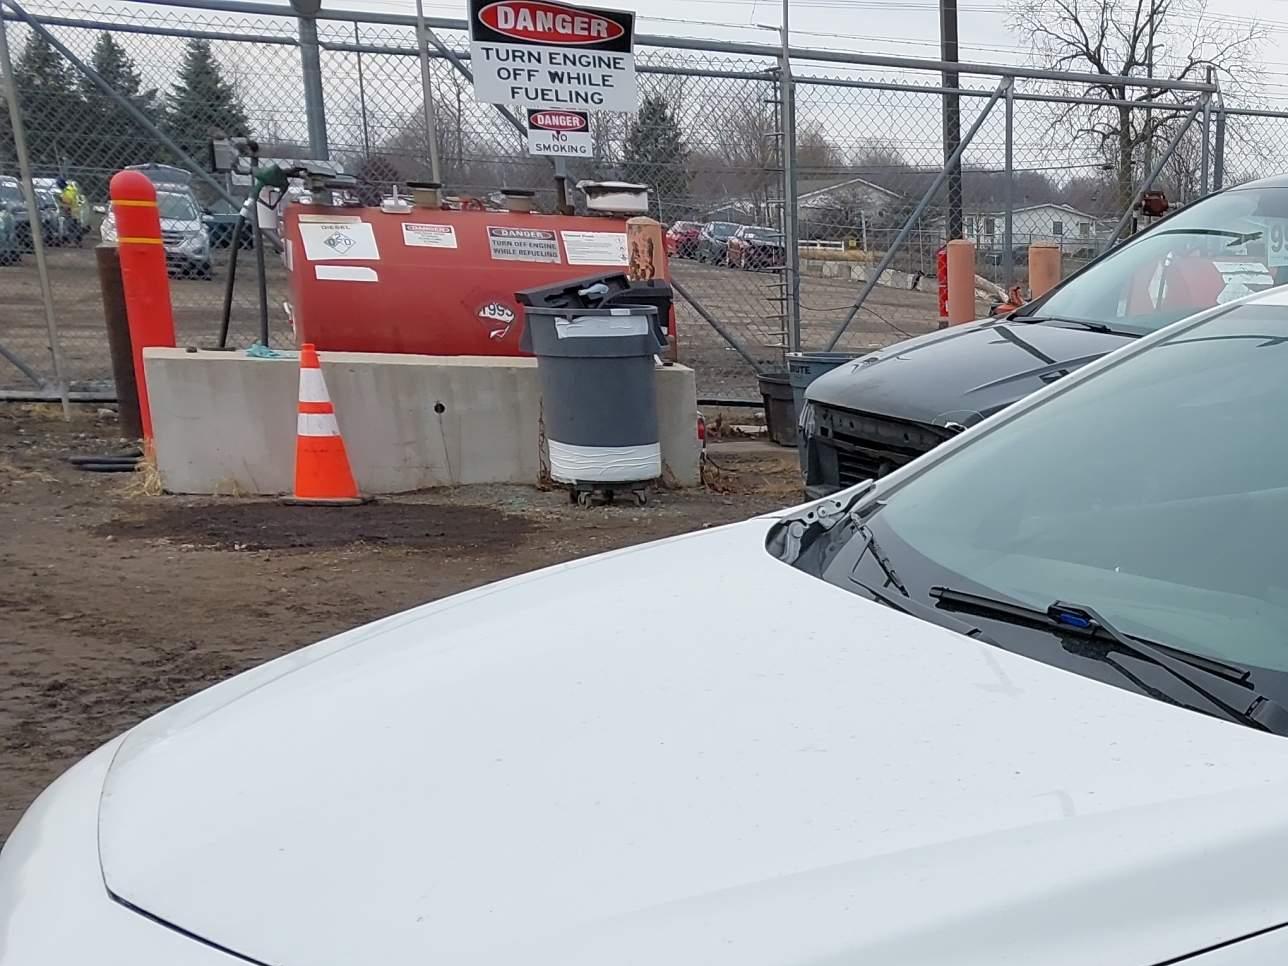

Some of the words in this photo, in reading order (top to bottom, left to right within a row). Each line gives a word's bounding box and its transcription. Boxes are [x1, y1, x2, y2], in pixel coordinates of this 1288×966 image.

[496, 5, 608, 38] DANGER
[480, 47, 542, 65] TURN
[549, 52, 626, 71] ENGINE
[496, 67, 540, 83] OFF
[548, 70, 615, 88] WHILE
[510, 86, 604, 105] FUELING
[537, 114, 581, 127] DANGER
[551, 133, 568, 142] NO
[535, 143, 587, 154] SMOKING
[501, 230, 544, 239] DANGER
[519, 250, 558, 258] REFUELING
